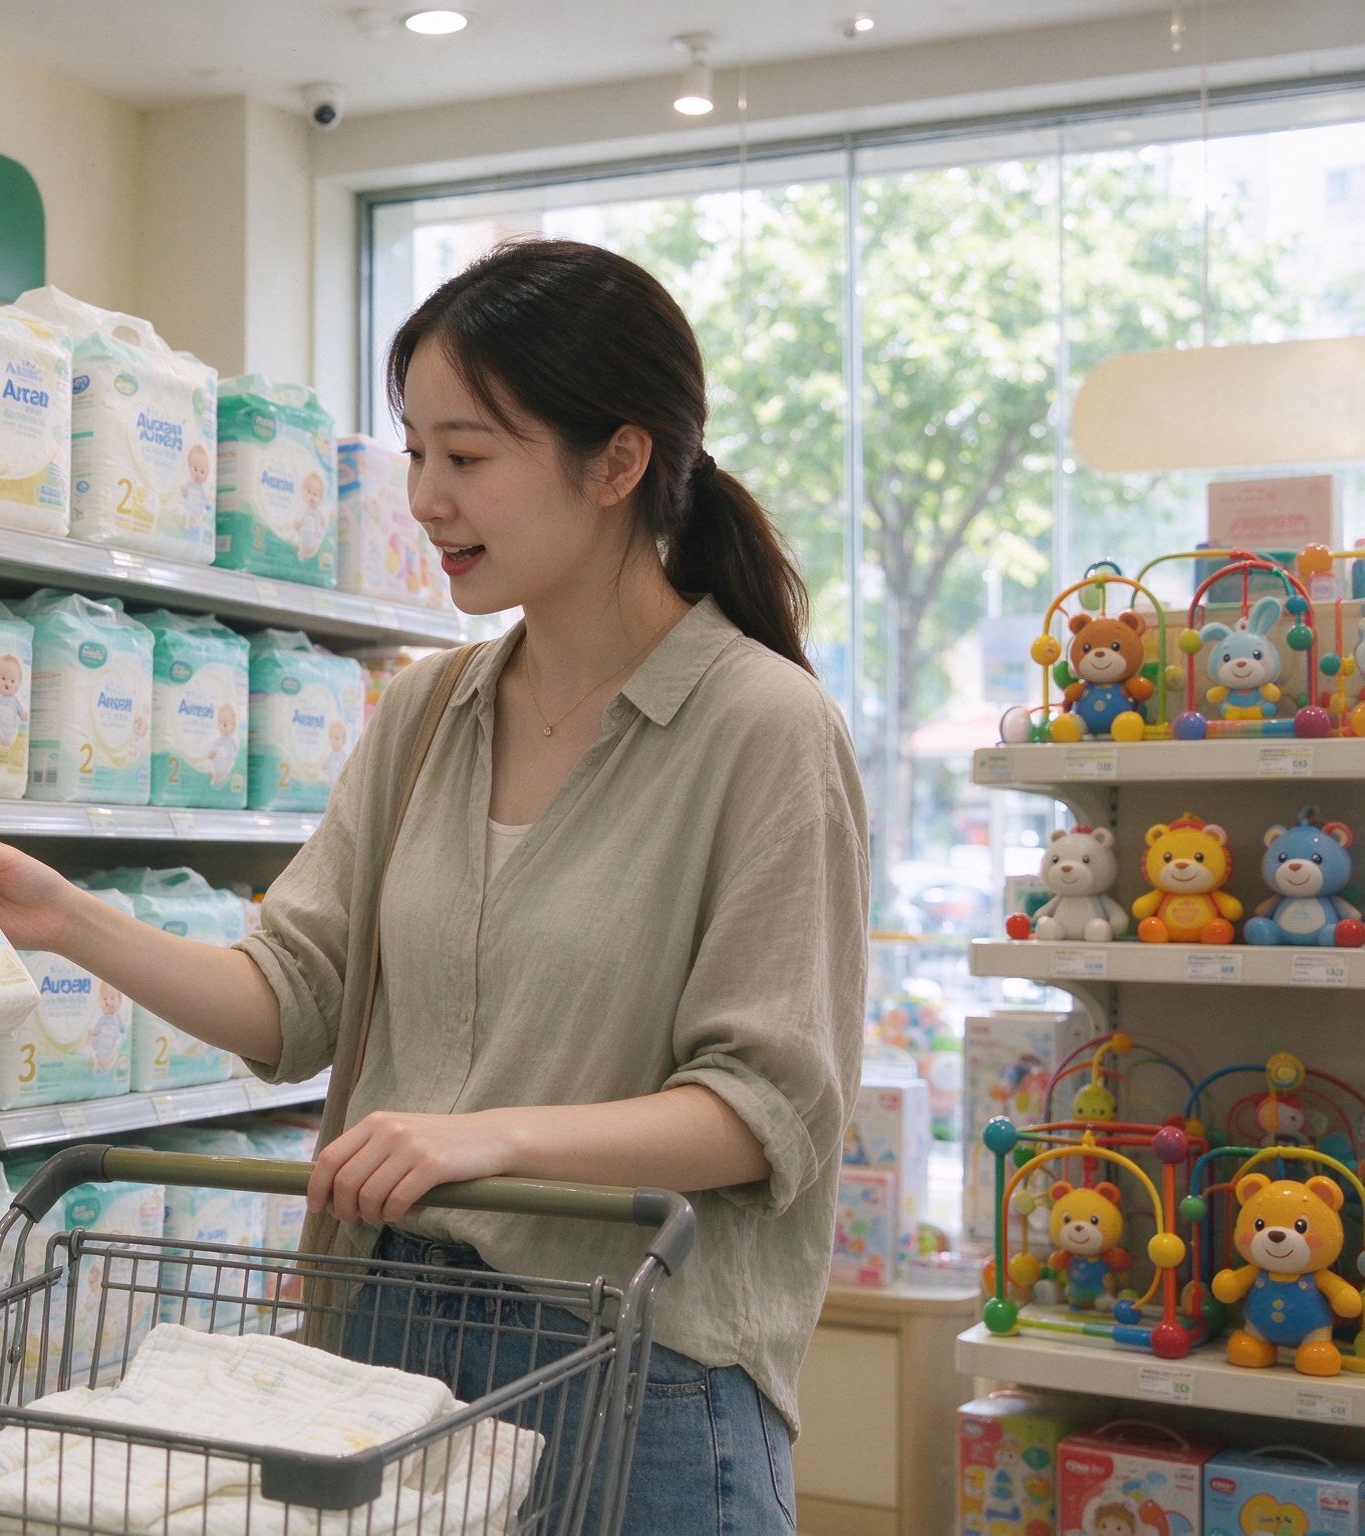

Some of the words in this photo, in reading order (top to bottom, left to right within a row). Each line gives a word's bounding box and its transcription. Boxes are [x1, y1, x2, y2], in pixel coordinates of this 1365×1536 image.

[117, 478, 132, 514] 2
[79, 744, 95, 774] 2
[19, 1043, 35, 1082] 3
[154, 1036, 169, 1066] 2
